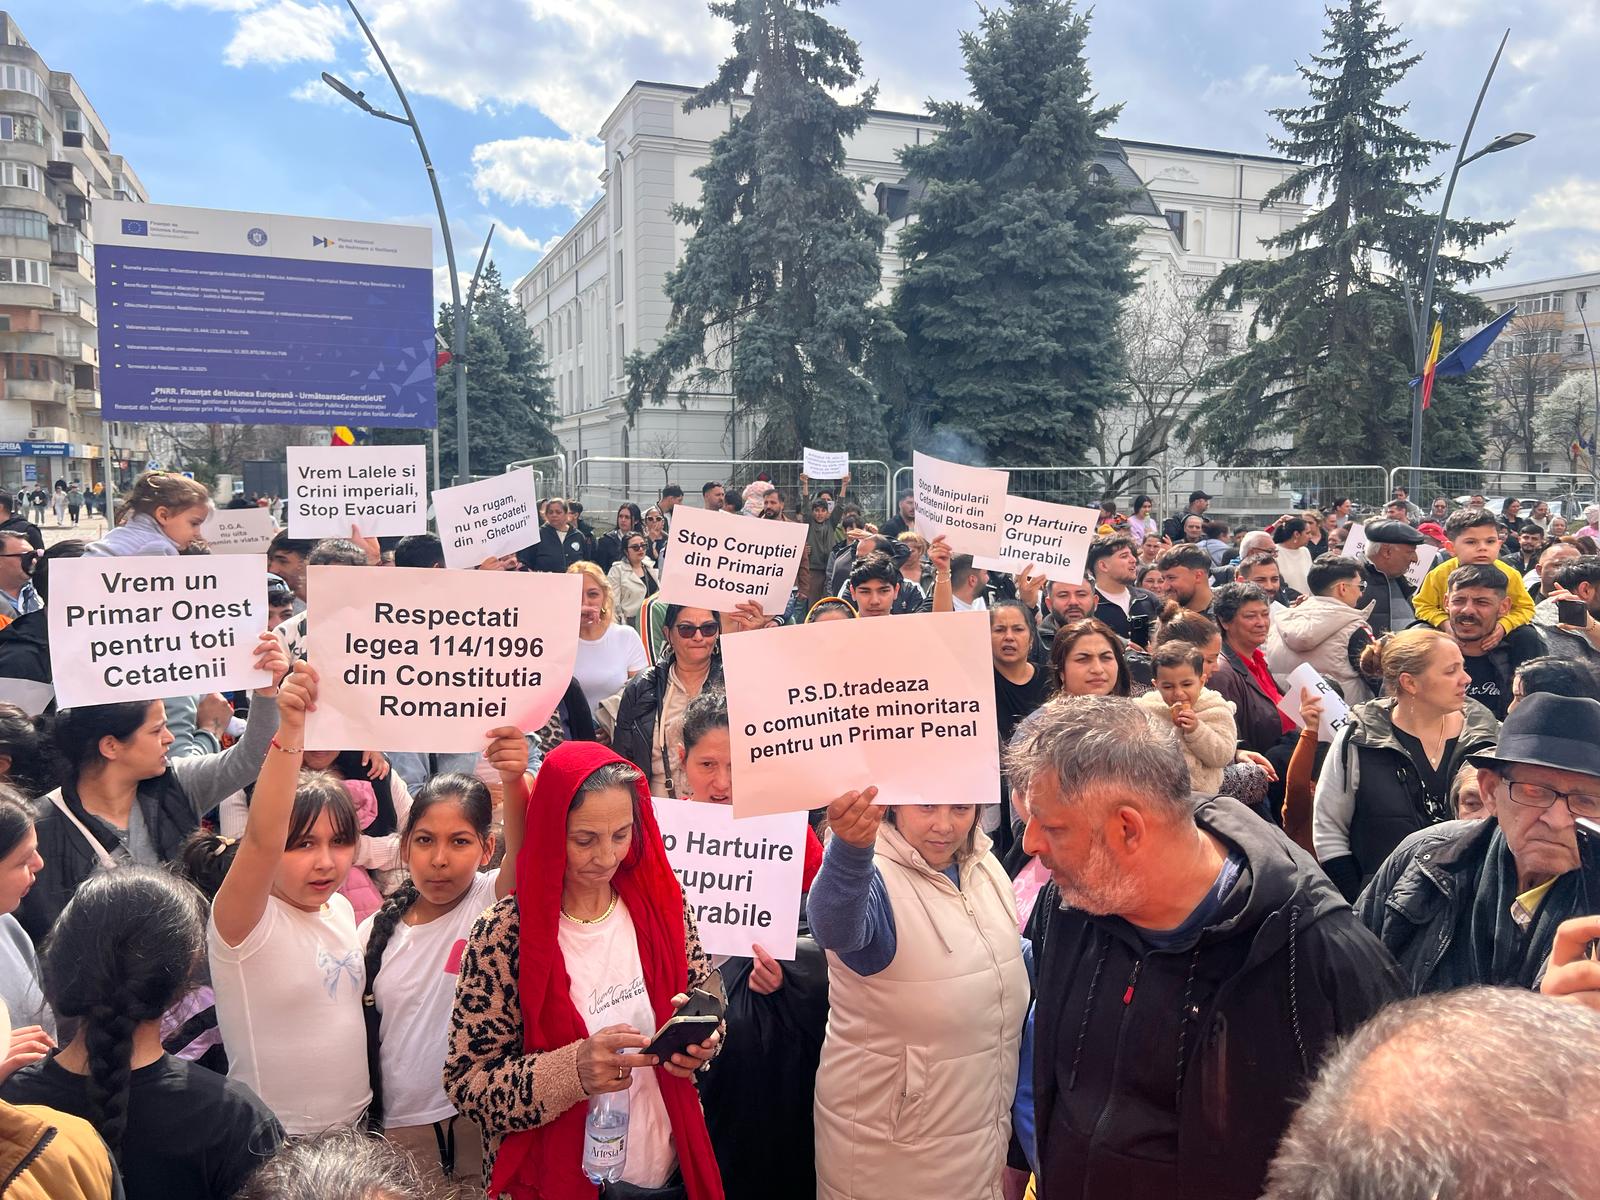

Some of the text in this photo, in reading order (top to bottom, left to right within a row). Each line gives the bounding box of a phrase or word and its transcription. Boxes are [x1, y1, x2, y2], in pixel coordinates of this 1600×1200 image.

[299, 465, 416, 479] Vrem Lalele si
[298, 484, 418, 500] Crini imperiali,
[919, 478, 989, 504] Stop Manipularii
[300, 502, 416, 518] Stop Evacuari
[464, 494, 516, 516] Va rugam,
[966, 506, 984, 517] din
[455, 502, 527, 533] nu ne scoateti
[946, 516, 996, 532] Botosani
[1004, 513, 1088, 534] op Hartuire
[454, 536, 474, 548] din
[678, 529, 798, 559] Stop Coruptiei
[1006, 528, 1062, 547] Grupuri
[684, 552, 784, 577] din Primaria
[1000, 545, 1070, 567] ulnerabile
[102, 572, 217, 593] Vrem un
[695, 573, 769, 596] Botosani
[67, 598, 253, 626] Primar Onest
[376, 602, 519, 630] Respectati
[91, 627, 235, 662] pentru toti
[346, 632, 544, 660] legea 114/1996
[103, 657, 226, 688] Cetatenii
[344, 664, 542, 688] din Constitutia
[788, 678, 929, 704] P.S.D.tradeaza
[380, 696, 507, 718] Romaniei
[744, 698, 980, 736] o comunitate minoritara
[750, 721, 976, 763] pentru un Primar Penal
[687, 831, 793, 862] Hartuire
[673, 868, 753, 893] upuri
[696, 902, 772, 928] rabile
[621, 992, 632, 1001] THE
